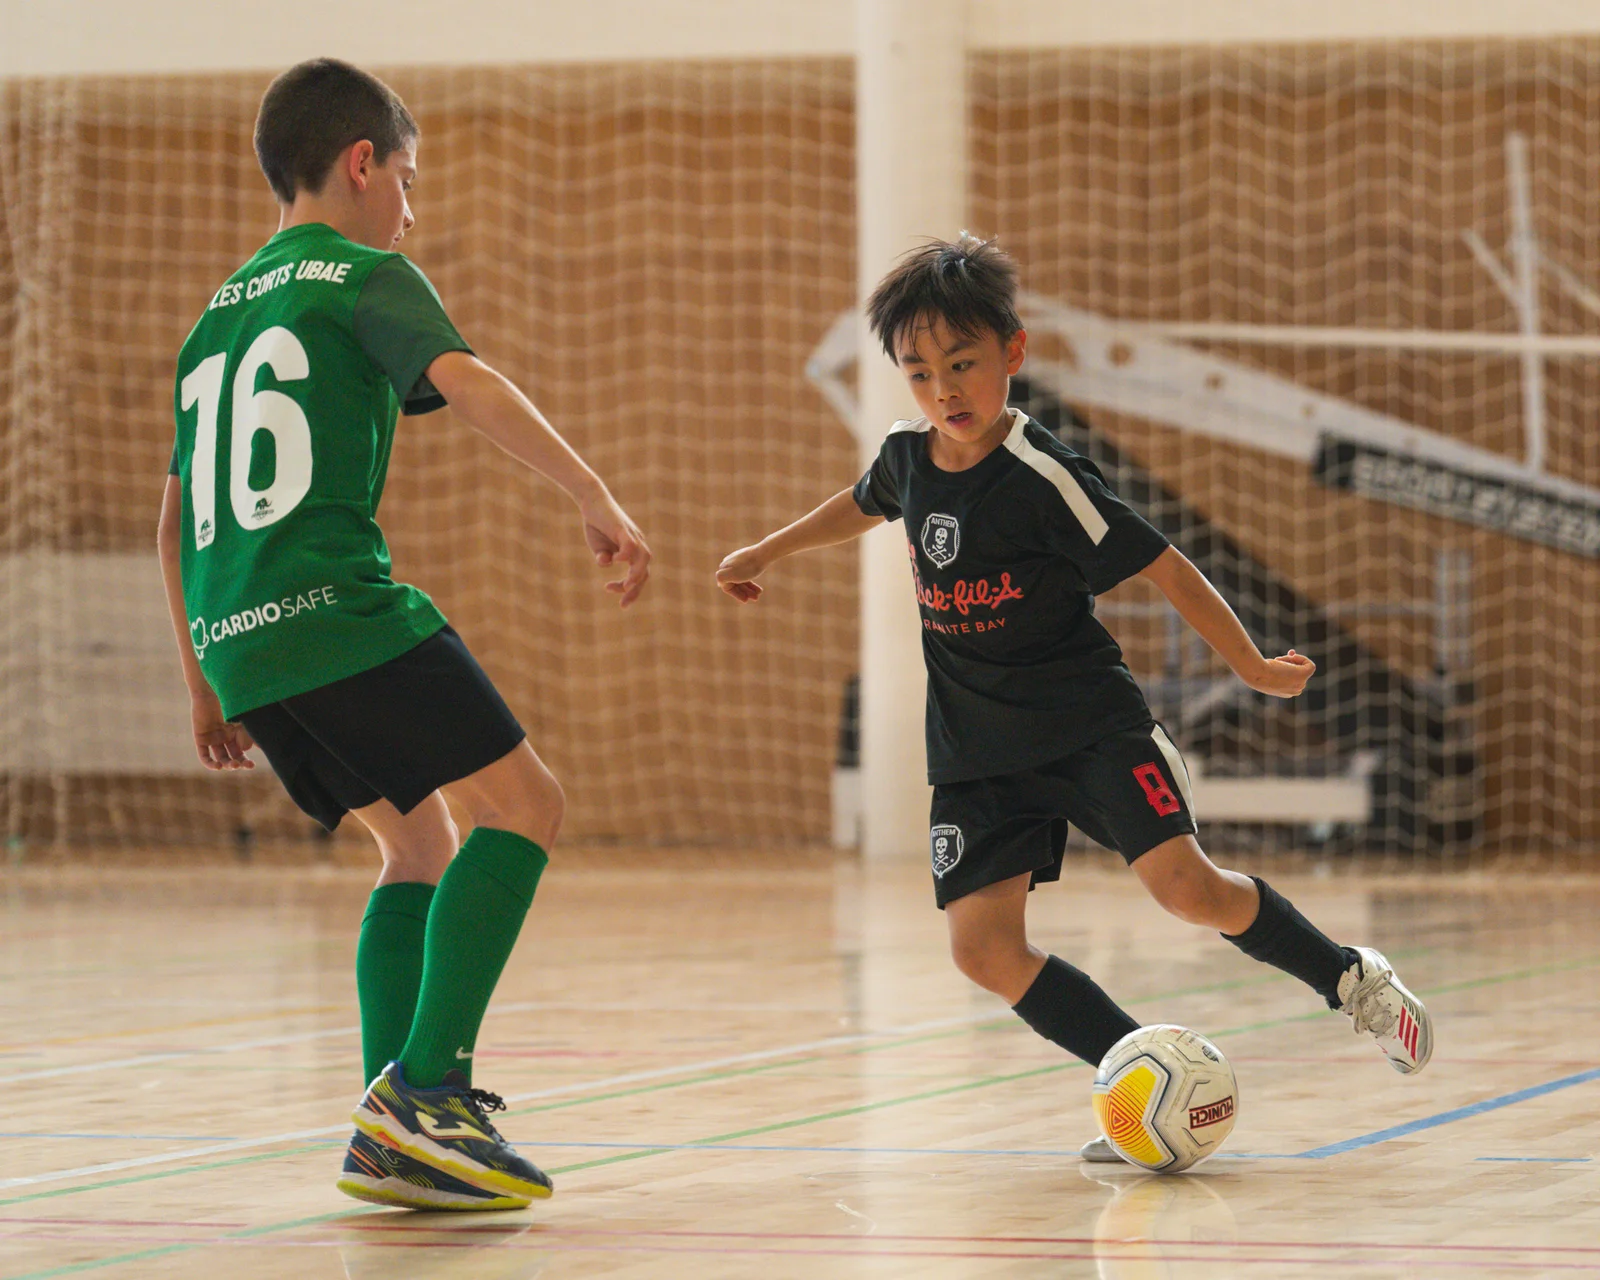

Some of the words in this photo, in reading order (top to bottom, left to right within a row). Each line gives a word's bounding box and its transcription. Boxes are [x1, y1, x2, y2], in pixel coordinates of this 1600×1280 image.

[208, 281, 244, 311] LES
[246, 262, 295, 300] CORTS
[295, 260, 353, 284] UBAE
[181, 326, 313, 552] 16
[931, 517, 955, 528] ANTHEM
[908, 545, 1024, 615] ick-fil-A
[211, 585, 338, 642] CARDIOSAFE
[923, 618, 969, 634] RANITE
[975, 618, 1006, 632] BAY
[1132, 762, 1180, 817] 8
[1190, 1099, 1233, 1126] MUNICH
